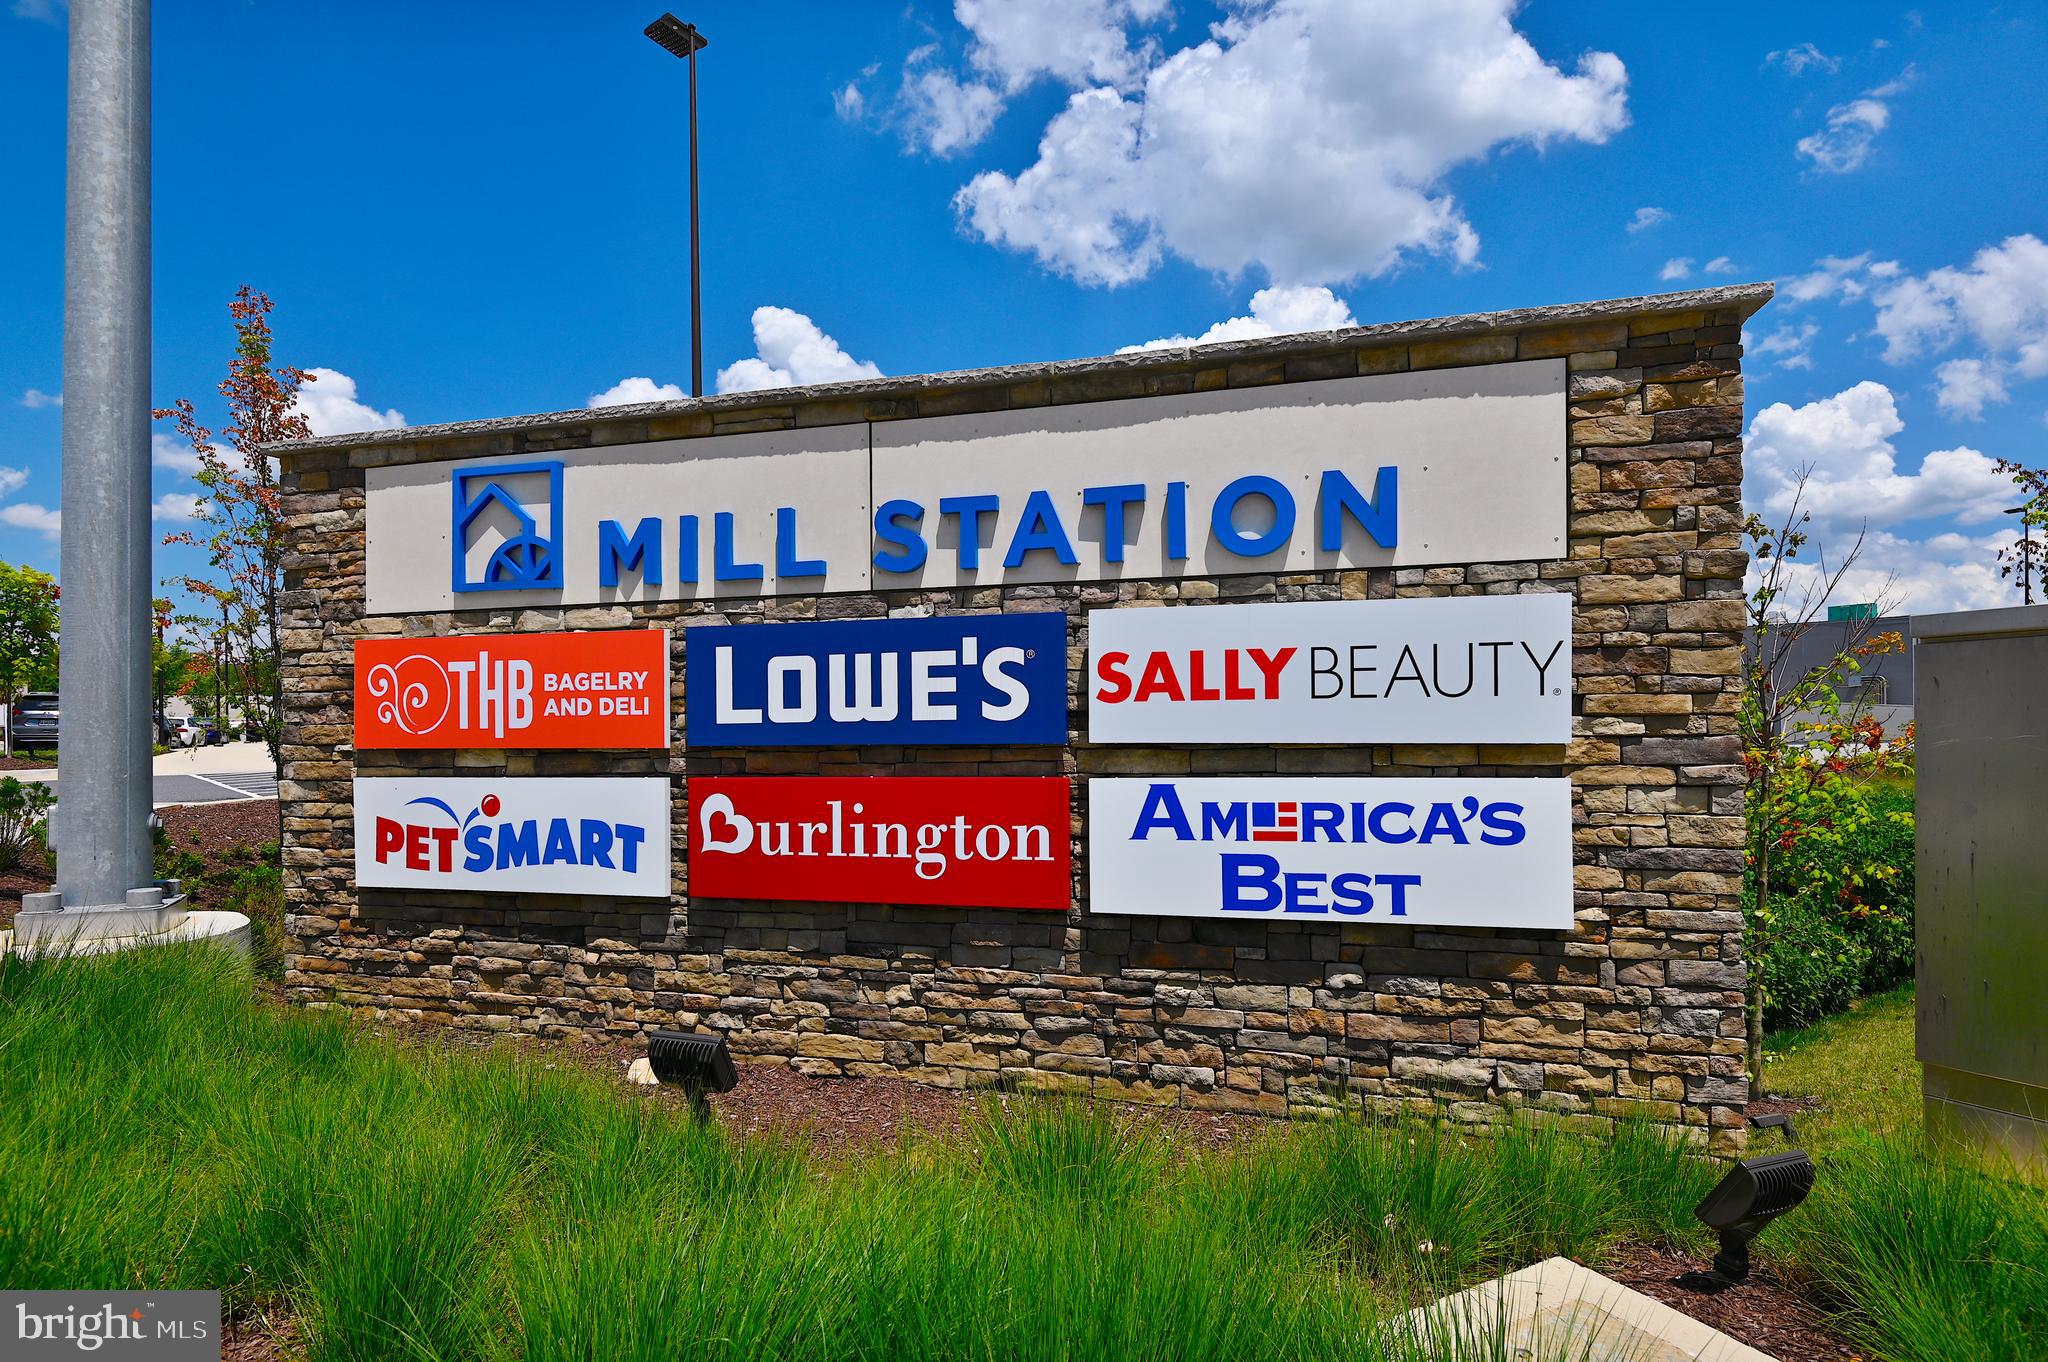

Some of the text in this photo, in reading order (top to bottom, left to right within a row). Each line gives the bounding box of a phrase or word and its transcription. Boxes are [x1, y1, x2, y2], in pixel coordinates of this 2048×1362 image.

[599, 466, 1398, 588] MILL STATION
[448, 651, 533, 739] THB
[544, 671, 649, 693] BAGELRY
[544, 697, 650, 717] AND DELI
[714, 636, 1031, 725] LOWE'S
[1096, 640, 1565, 704] SALLY BEAUTY
[700, 793, 1056, 880] Burlington
[1219, 853, 1422, 916] BEST
